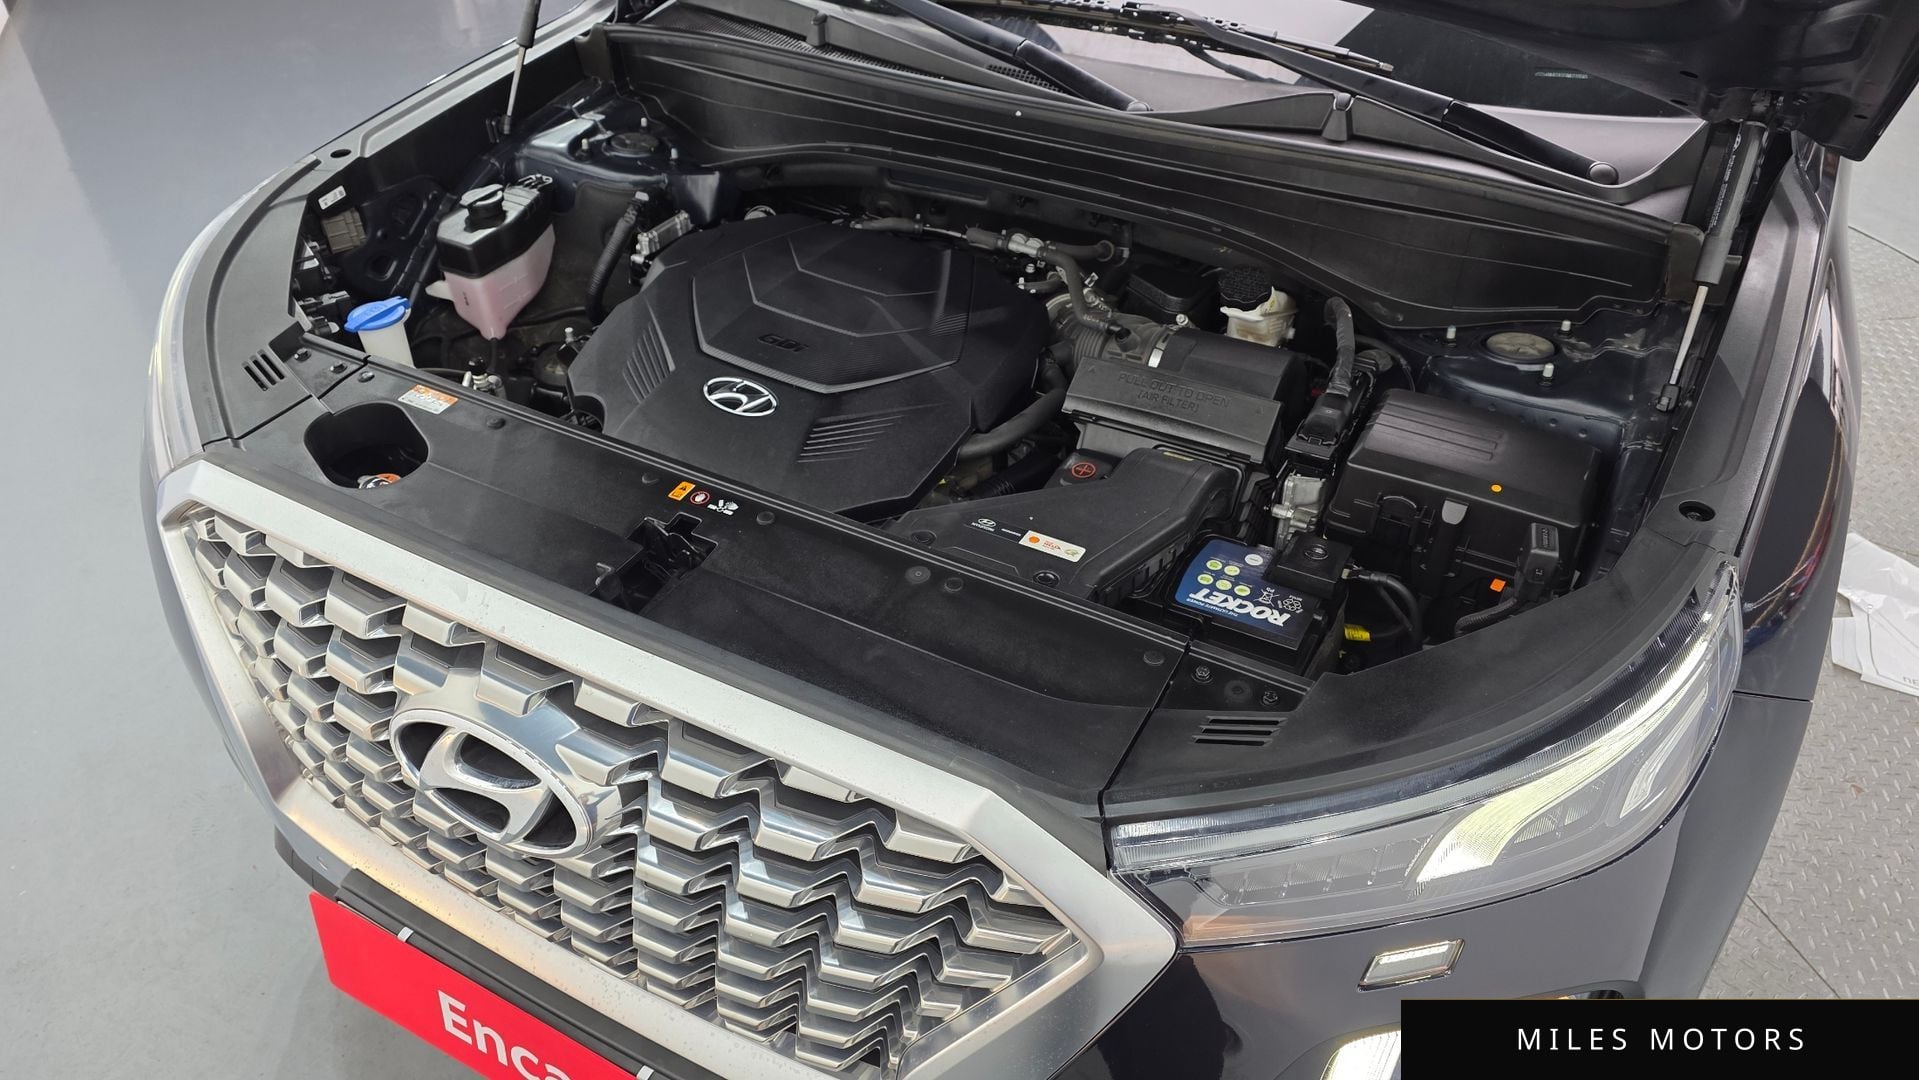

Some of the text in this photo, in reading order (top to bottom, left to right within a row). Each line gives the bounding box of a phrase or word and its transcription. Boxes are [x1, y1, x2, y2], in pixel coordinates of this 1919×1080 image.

[1118, 373, 1231, 408] PULL OUT TO OPEN
[1137, 390, 1200, 412] (AIR FILTER)
[1186, 597, 1205, 607] POWER
[1189, 588, 1291, 626] ROCKET
